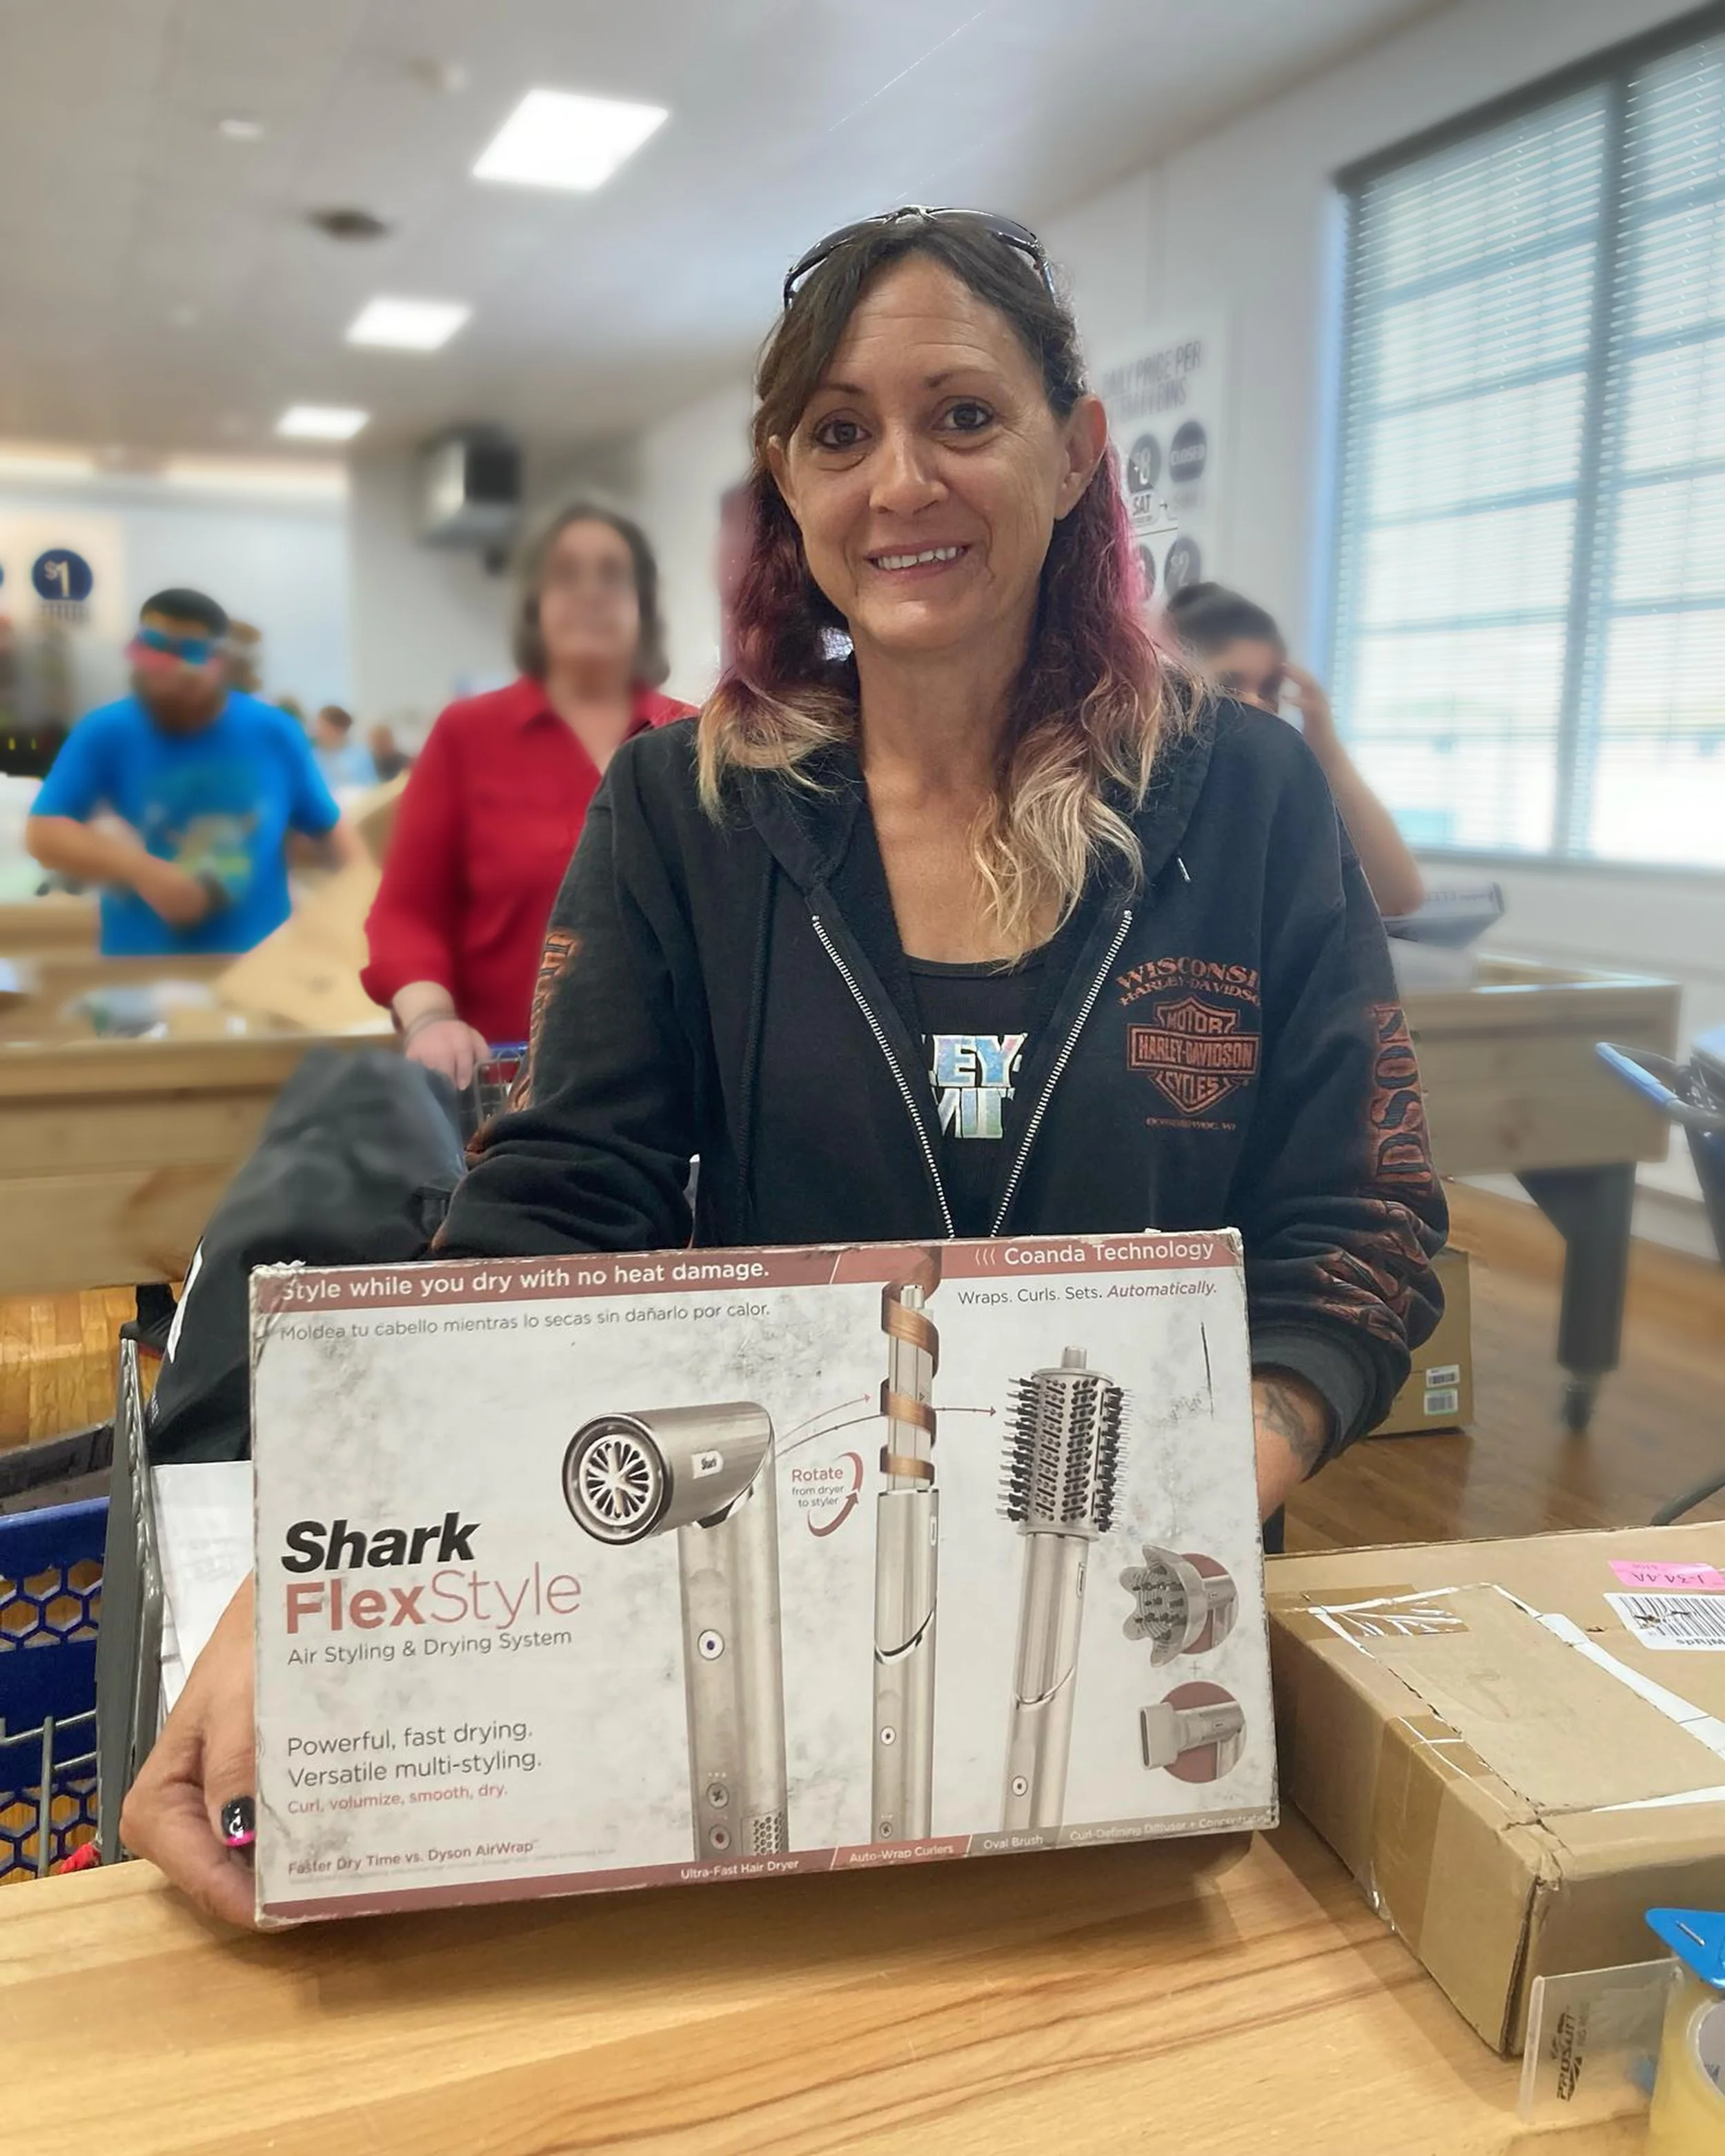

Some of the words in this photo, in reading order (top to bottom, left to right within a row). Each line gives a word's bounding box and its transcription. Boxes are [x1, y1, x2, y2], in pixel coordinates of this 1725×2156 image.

[1175, 340, 1202, 375] PER
[1133, 494, 1151, 516] SAT
[44, 560, 70, 598] $1
[1116, 956, 1261, 989] WISCONSI
[1166, 1007, 1223, 1034] MOTOR
[1138, 1034, 1254, 1068] HARLEY-DAVIDSON
[1166, 1072, 1219, 1105] CYCLES
[1004, 1244, 1085, 1265] Coanda
[1092, 1240, 1214, 1261] Technology
[283, 1278, 341, 1302] Style
[349, 1276, 412, 1297] while
[420, 1276, 465, 1297] you
[472, 1272, 512, 1293] dry
[520, 1267, 570, 1289] with
[578, 1269, 607, 1285] no
[614, 1264, 664, 1283] heat
[671, 1262, 769, 1281] damage.
[958, 1289, 1012, 1306] Wraps.
[1017, 1287, 1060, 1303] Curls.
[1065, 1286, 1102, 1300] Sets.
[1107, 1280, 1217, 1298] Automatically.
[280, 1325, 346, 1342] Moldea
[351, 1323, 369, 1338] tu
[375, 1320, 437, 1336] cabello
[444, 1316, 518, 1332] mientras
[523, 1314, 540, 1329] lo
[544, 1314, 591, 1327] secas
[597, 1309, 620, 1323] sin
[625, 1305, 689, 1323] dañarlo
[693, 1307, 722, 1321] por
[727, 1302, 770, 1317] calor.
[791, 1467, 844, 1483] Rotate
[791, 1486, 816, 1496] from
[818, 1485, 845, 1496] dryer
[798, 1498, 809, 1507] to
[811, 1496, 839, 1508] styler
[280, 1511, 482, 1574] Shark
[286, 1561, 582, 1634] FlexStyle
[287, 1648, 317, 1666] Air
[324, 1641, 395, 1664] Styling
[402, 1640, 416, 1656] &
[424, 1634, 492, 1656] Drying
[498, 1630, 572, 1652] System
[288, 1729, 396, 1757] Powerful,
[403, 1726, 446, 1748] fast
[453, 1720, 533, 1745] drying.
[287, 1762, 387, 1788] Versatile
[395, 1750, 542, 1779] multi-styling.
[288, 1798, 324, 1815] Curl,
[329, 1792, 405, 1810] volumize,
[409, 1786, 474, 1804] smooth,
[478, 1783, 508, 1799] dry.
[983, 1837, 1009, 1850] Oval
[1012, 1834, 1043, 1848] Brush
[1070, 1827, 1140, 1841] Curl-Defining
[1144, 1821, 1187, 1834] Diffuser
[288, 1858, 333, 1875] Faster
[336, 1856, 362, 1871] Dry
[366, 1852, 401, 1868] Time
[404, 1850, 424, 1864] vs.
[428, 1847, 472, 1864] Dyson
[680, 1864, 738, 1880] Ultra-Fast
[740, 1863, 765, 1874] Hair
[767, 1860, 800, 1872] Dryer
[849, 1849, 912, 1863] Auto-Wrap
[914, 1845, 954, 1857] Curlers
